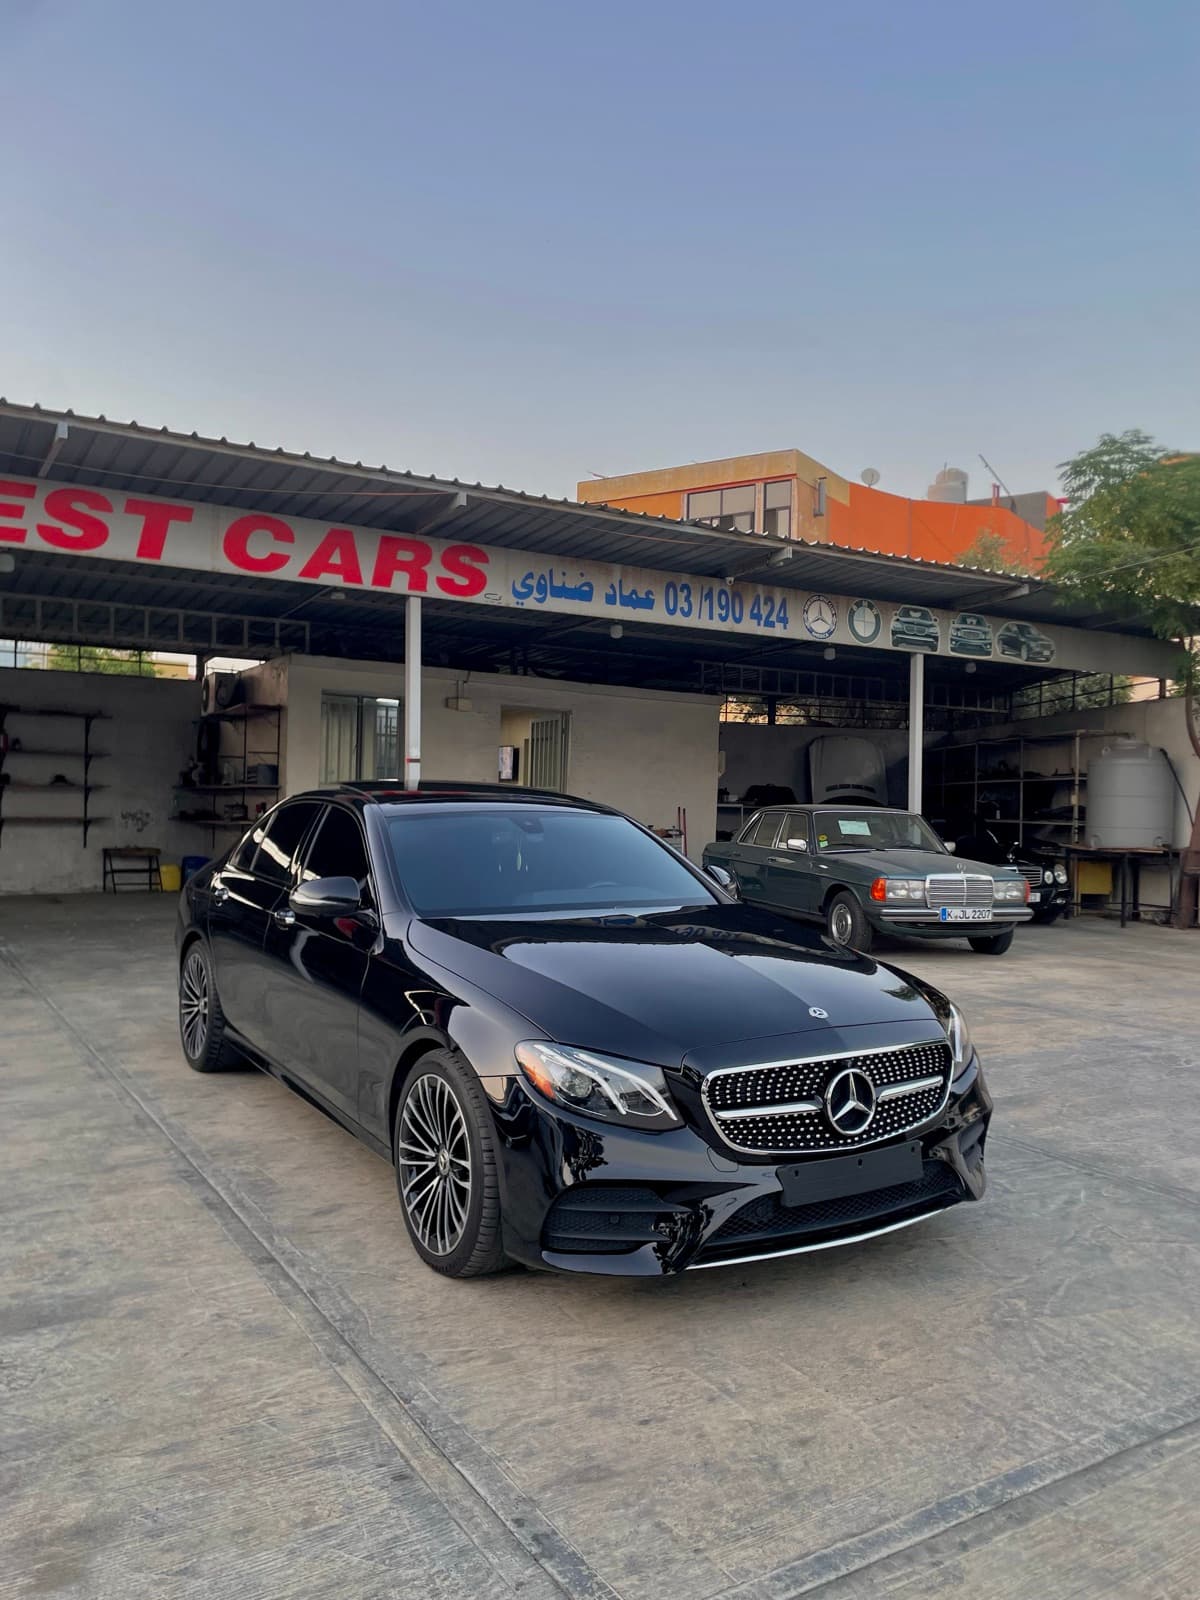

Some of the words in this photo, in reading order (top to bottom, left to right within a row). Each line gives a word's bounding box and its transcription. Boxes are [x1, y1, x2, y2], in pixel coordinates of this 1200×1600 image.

[222, 514, 490, 598] CARS
[511, 567, 595, 607] ضناوي
[604, 579, 656, 610] عماد
[749, 593, 790, 630] 424
